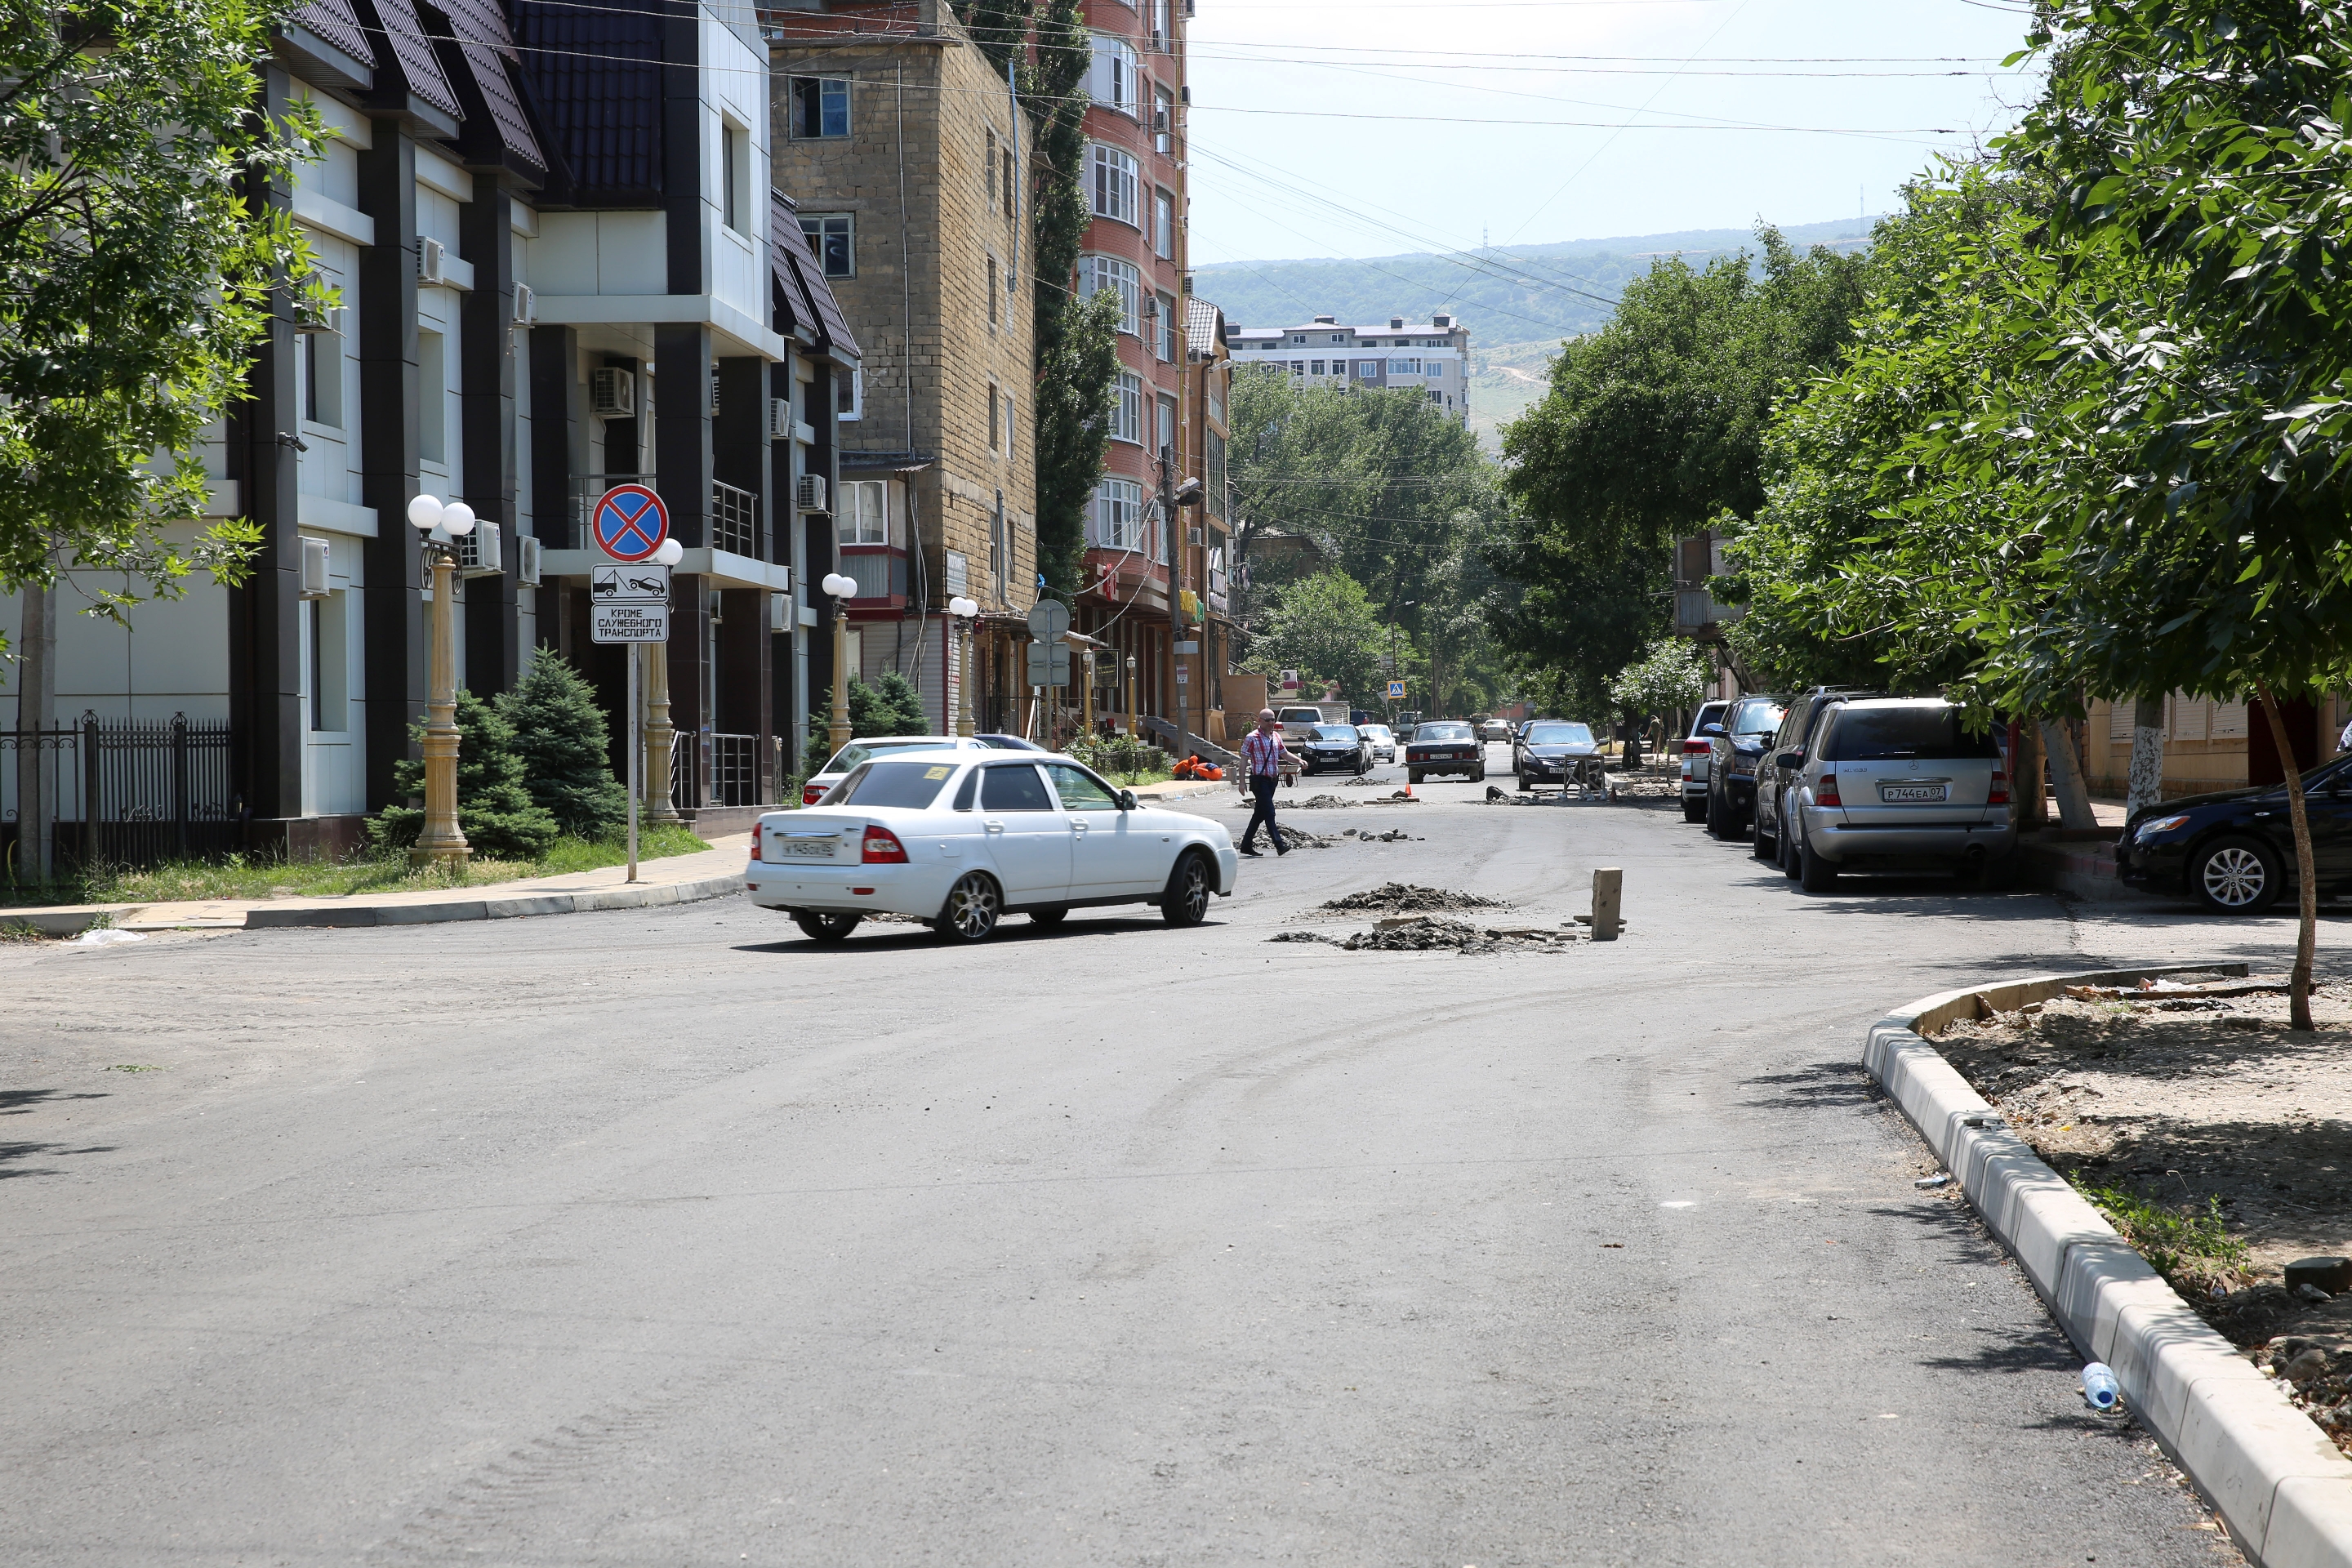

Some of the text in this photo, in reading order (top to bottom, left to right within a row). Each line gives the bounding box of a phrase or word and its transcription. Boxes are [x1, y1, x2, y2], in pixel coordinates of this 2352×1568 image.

[611, 608, 643, 618] КРОМЕ
[598, 618, 662, 628] СЛУЖЕБНОГО
[598, 628, 662, 637] ТРАНСПОРТА
